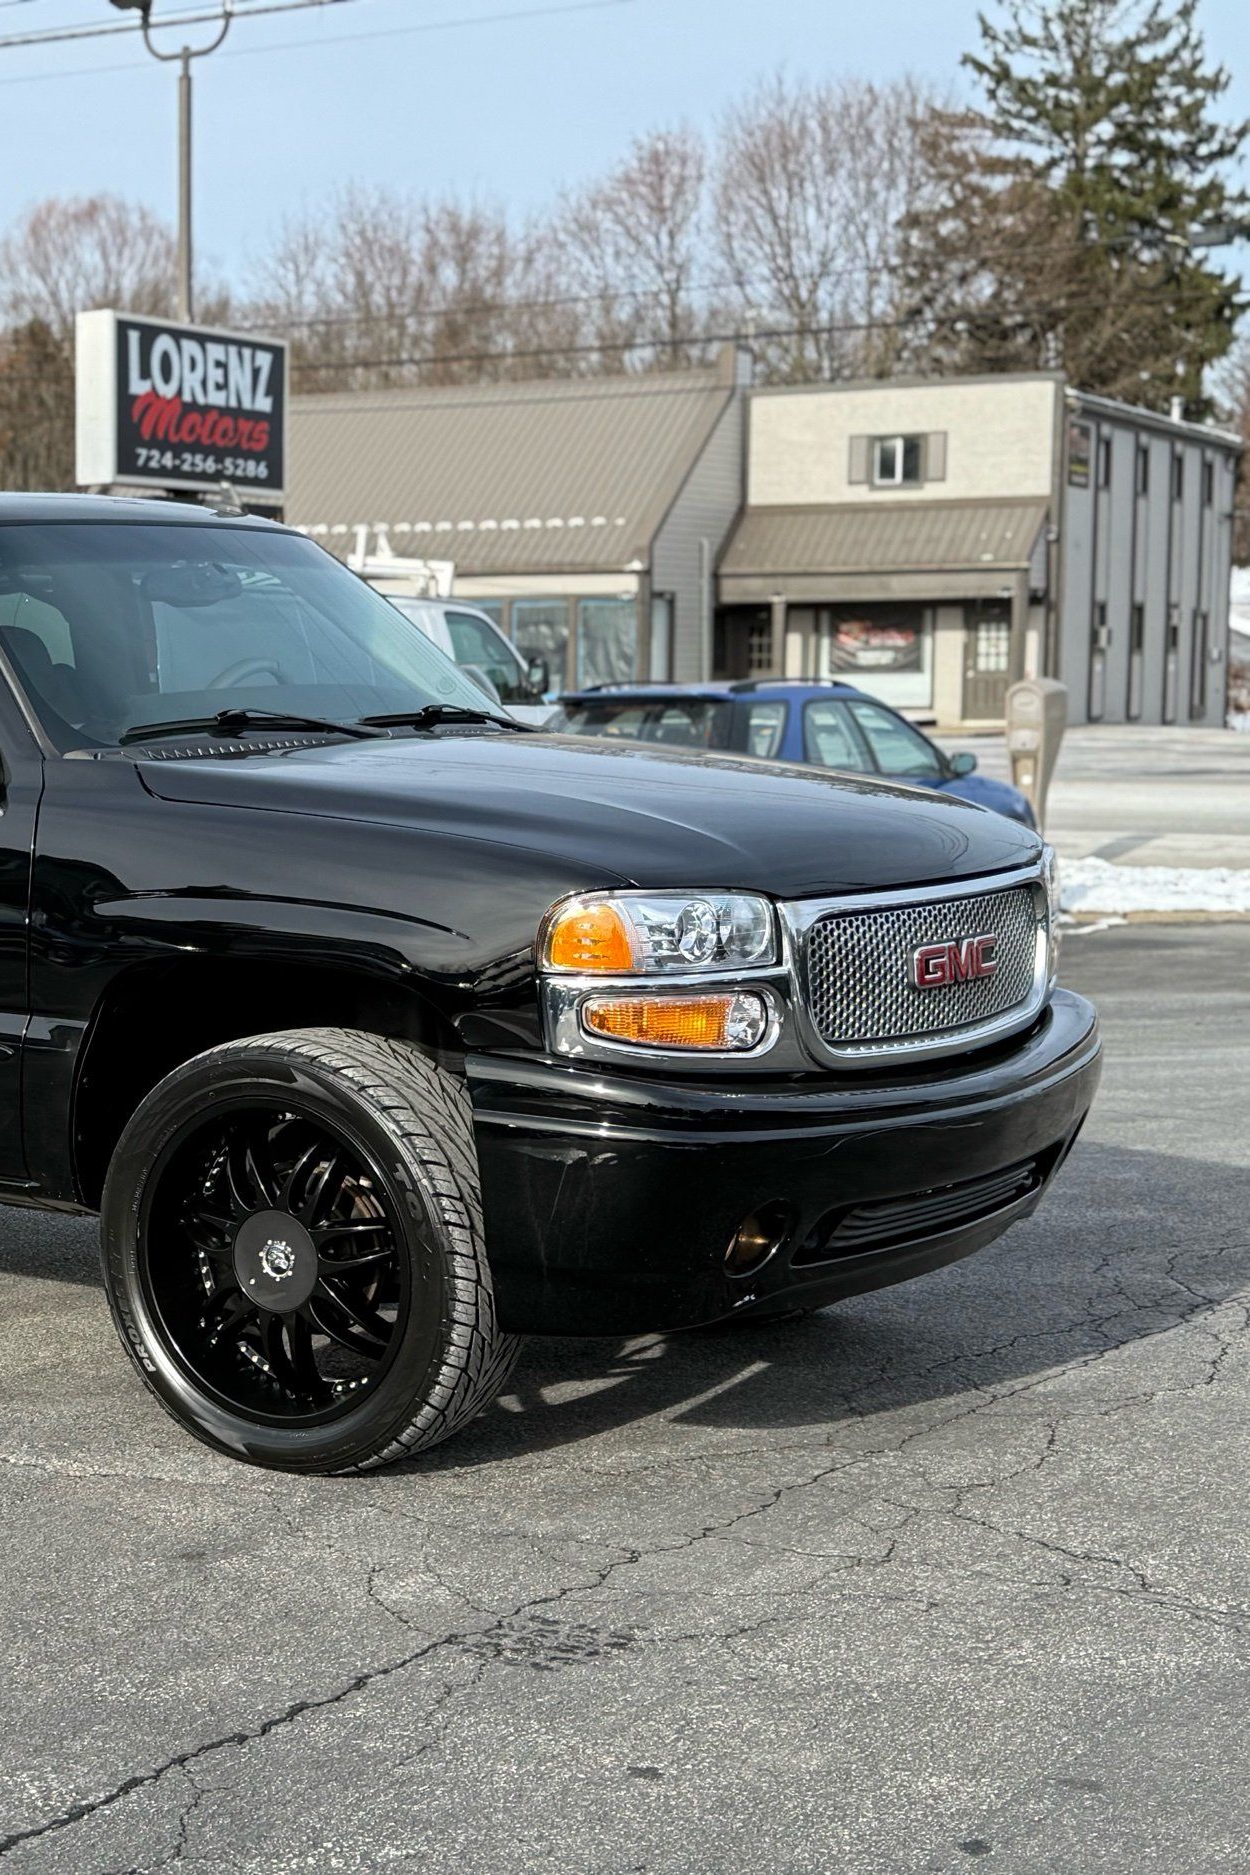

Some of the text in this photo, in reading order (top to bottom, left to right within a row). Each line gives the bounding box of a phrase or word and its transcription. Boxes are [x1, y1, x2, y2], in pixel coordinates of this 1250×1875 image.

[126, 328, 273, 413] LORENZ
[131, 389, 270, 453] Motors
[135, 447, 268, 479] 724-256-5286
[913, 933, 998, 990] GMC
